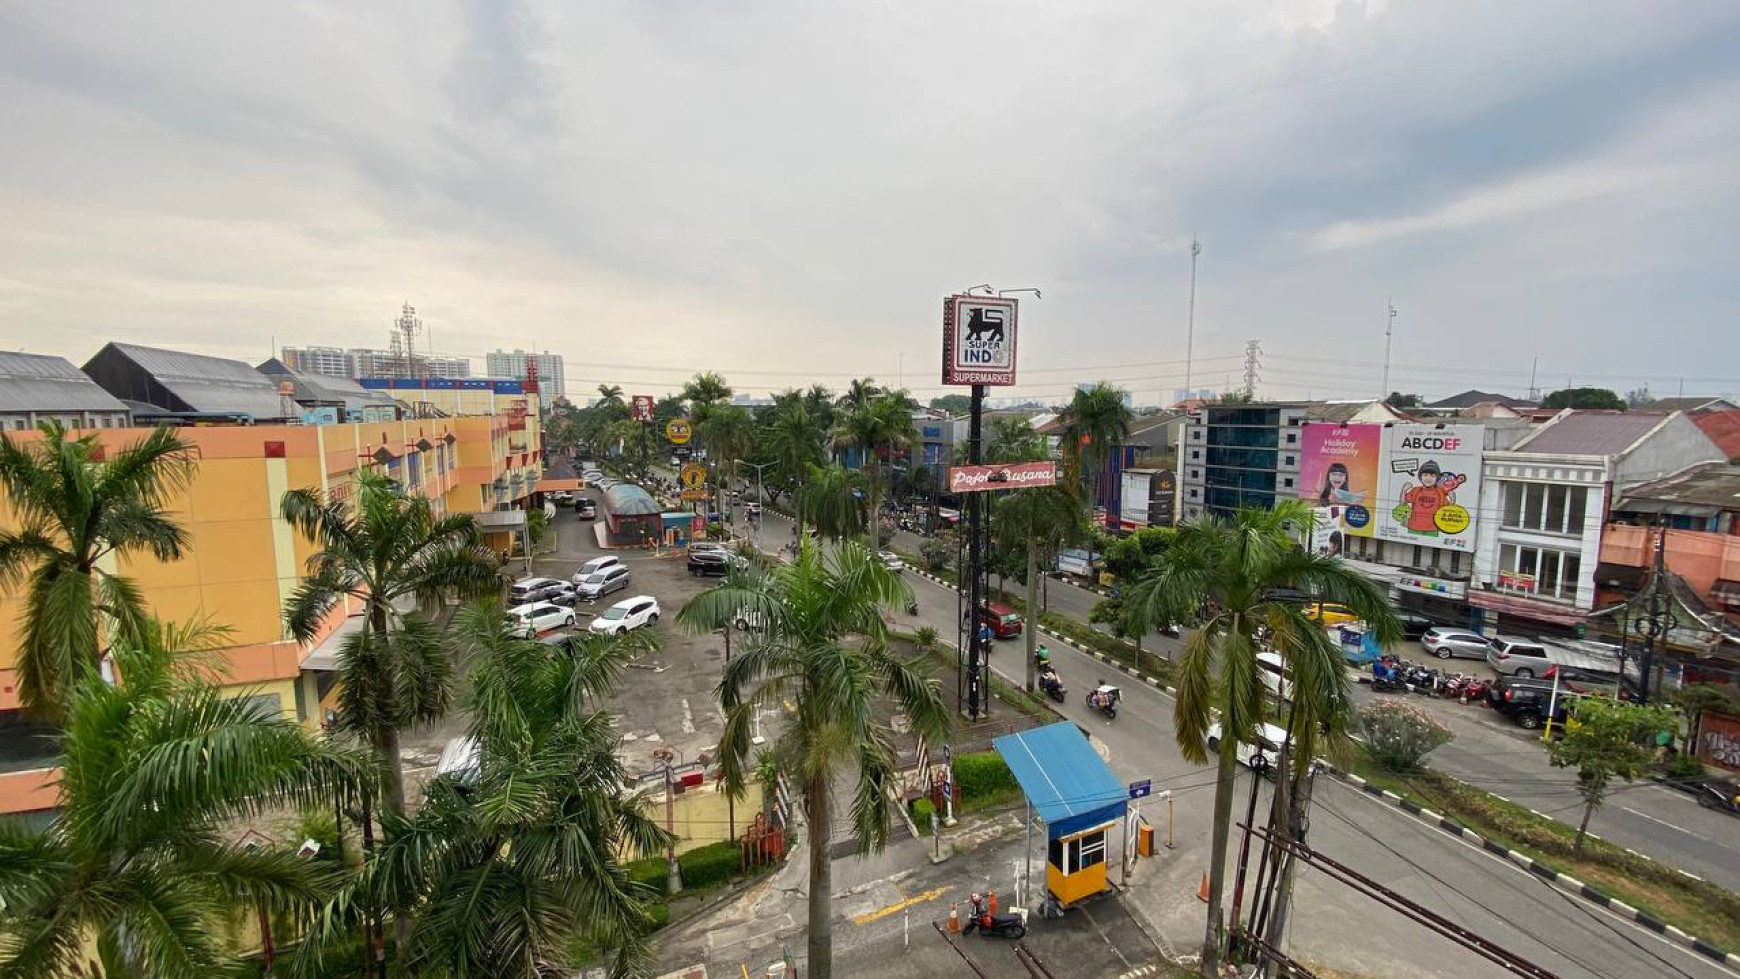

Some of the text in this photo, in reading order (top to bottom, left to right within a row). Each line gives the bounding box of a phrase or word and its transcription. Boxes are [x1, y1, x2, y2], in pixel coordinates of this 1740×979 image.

[968, 341, 1000, 349] SUPER
[964, 350, 1003, 363] INDO
[954, 372, 1013, 383] SUPERMARKET
[1323, 438, 1356, 449] Holiday
[1401, 437, 1461, 450] ABCDEF
[1320, 446, 1359, 458] Academy
